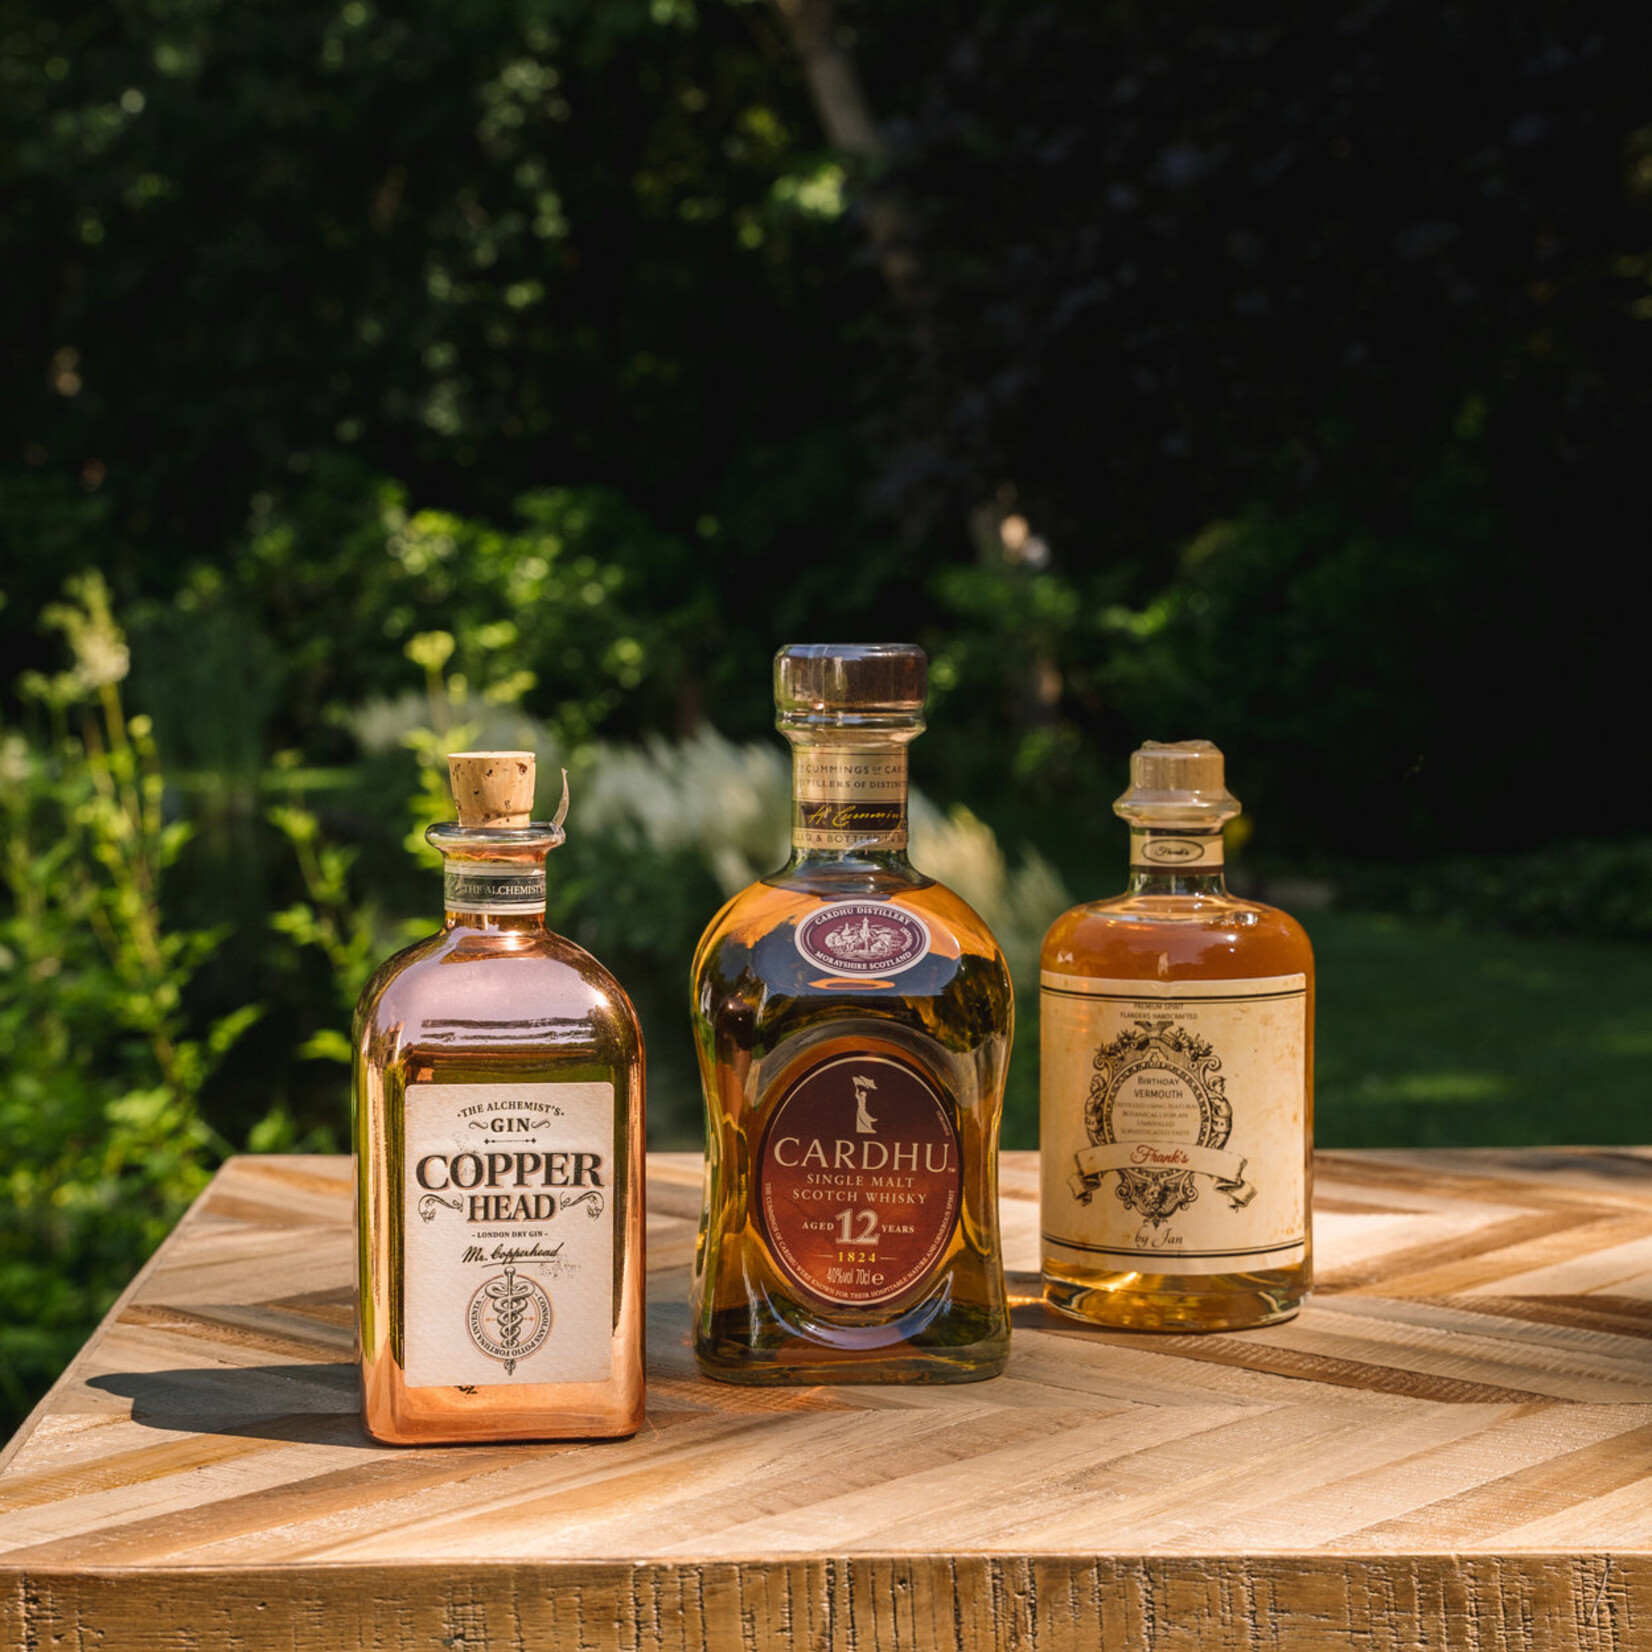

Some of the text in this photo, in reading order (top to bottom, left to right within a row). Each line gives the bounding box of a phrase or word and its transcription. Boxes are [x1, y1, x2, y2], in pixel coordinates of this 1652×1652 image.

[463, 884, 481, 894] THE
[815, 907, 912, 926] CARDHU DISTILLERY
[869, 951, 912, 970] SCOTLAND
[1138, 1076, 1179, 1085] BIRTHDAY
[1134, 1088, 1183, 1098] VERMOUTH
[460, 1100, 562, 1118] THE ALCHEMIST'S
[491, 1118, 531, 1132] GIN
[774, 1136, 950, 1173] CARDHU
[1130, 1144, 1189, 1165] Frank's
[415, 1152, 605, 1190] COPPER
[807, 1173, 915, 1188] SINGLE MALT
[792, 1189, 927, 1204] SCOTCH WHISKY
[467, 1193, 556, 1222] HEAD
[477, 1231, 510, 1239] LONDON
[802, 1208, 915, 1246] AGED 12 YEARS
[490, 1241, 565, 1265] Copperhead
[838, 1251, 877, 1263] 1824
[834, 1290, 849, 1298] FOR
[850, 1291, 870, 1299] THEIR
[471, 1296, 549, 1356] CONSOLANS POTIO FORTUNA INVENTA
